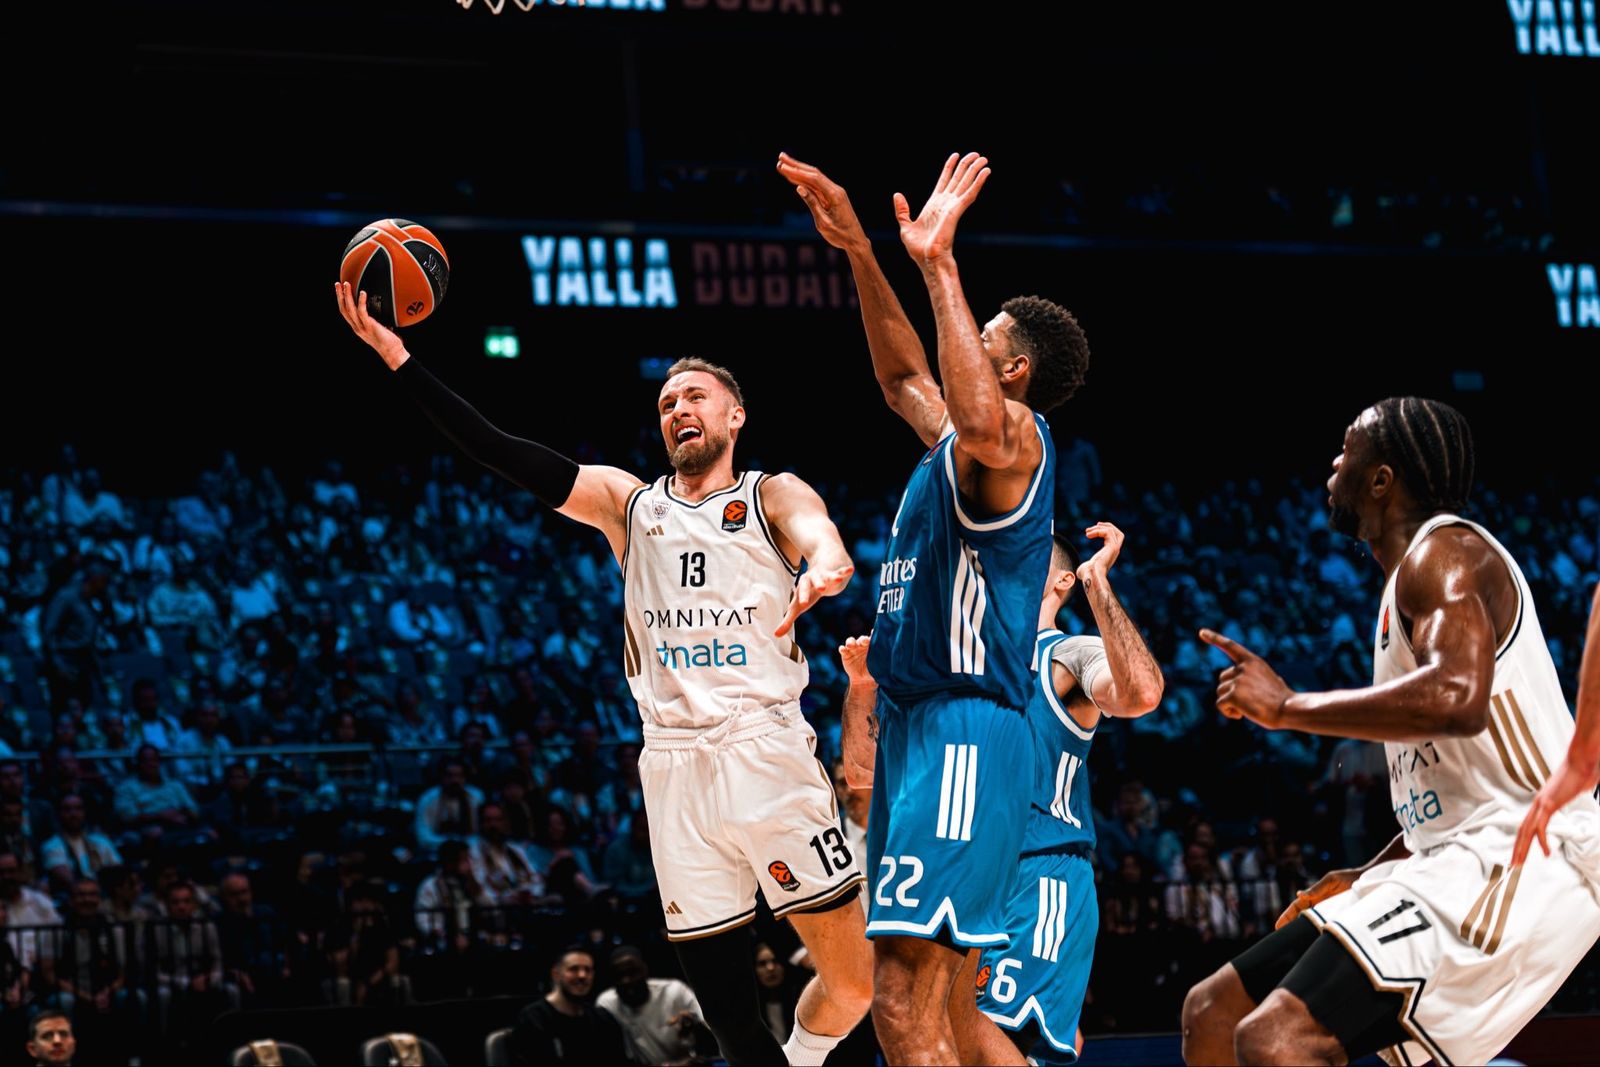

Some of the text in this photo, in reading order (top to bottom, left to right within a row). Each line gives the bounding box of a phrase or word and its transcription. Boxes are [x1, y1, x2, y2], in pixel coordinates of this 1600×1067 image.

[521, 235, 677, 307] YALLA
[680, 552, 706, 587] 13
[644, 607, 757, 628] OMNIYAT
[809, 826, 853, 877] 13
[876, 856, 924, 908] 22
[1368, 899, 1432, 945] 17
[991, 957, 1023, 1004] 6
